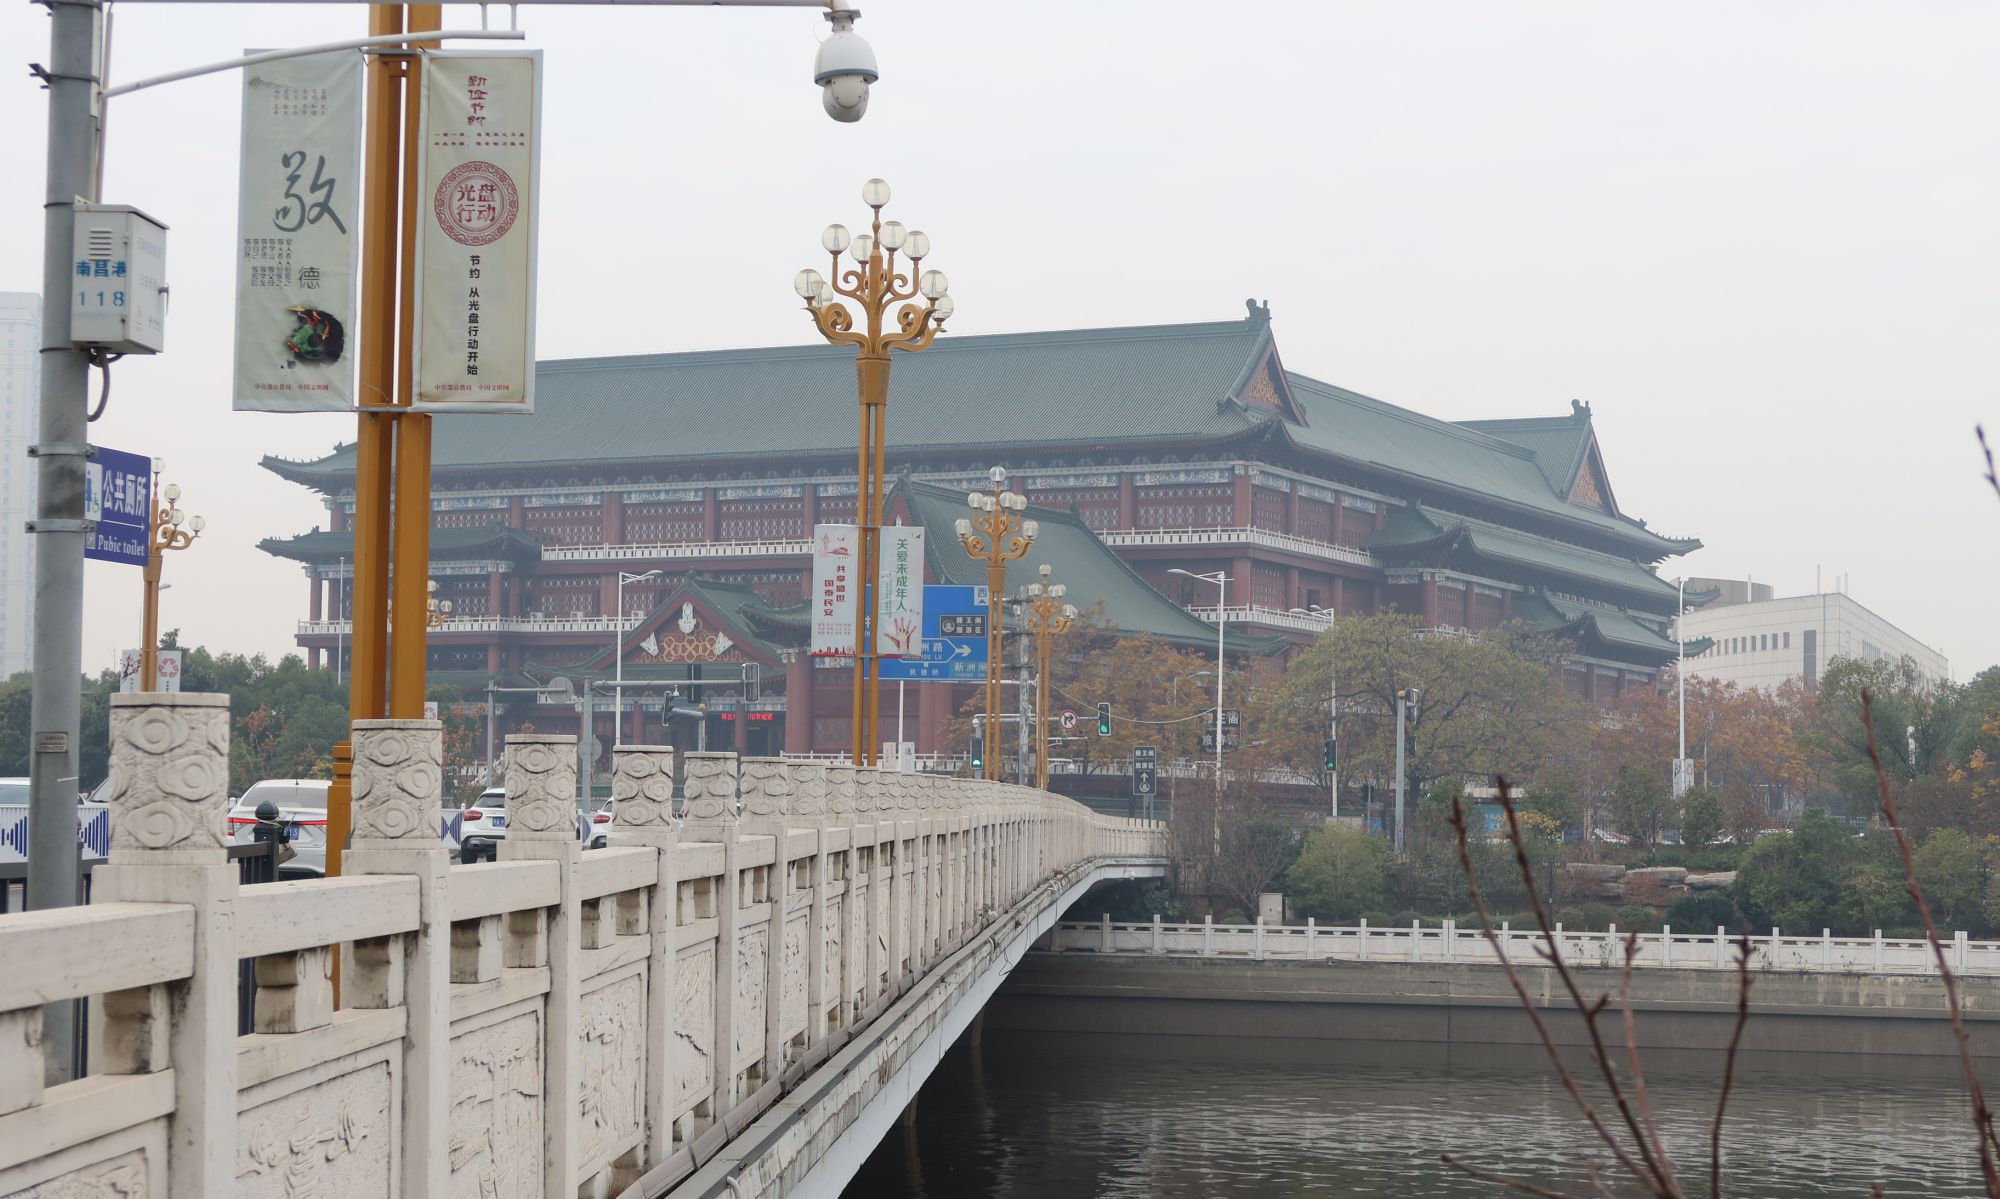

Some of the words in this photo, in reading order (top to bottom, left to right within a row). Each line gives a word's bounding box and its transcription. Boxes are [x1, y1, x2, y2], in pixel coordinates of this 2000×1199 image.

[297, 266, 321, 290] 德
[469, 255, 481, 279] 节约
[79, 291, 125, 307] 118
[467, 287, 480, 376] 从光盘行动开始
[102, 469, 147, 517] 公共厕所
[98, 534, 121, 553] Pubic
[123, 539, 145, 557] toilet
[836, 565, 846, 603] 共享盛世
[895, 538, 909, 612] 关爱未成年人
[824, 579, 834, 617] 国泰民安
[977, 587, 988, 598] 西
